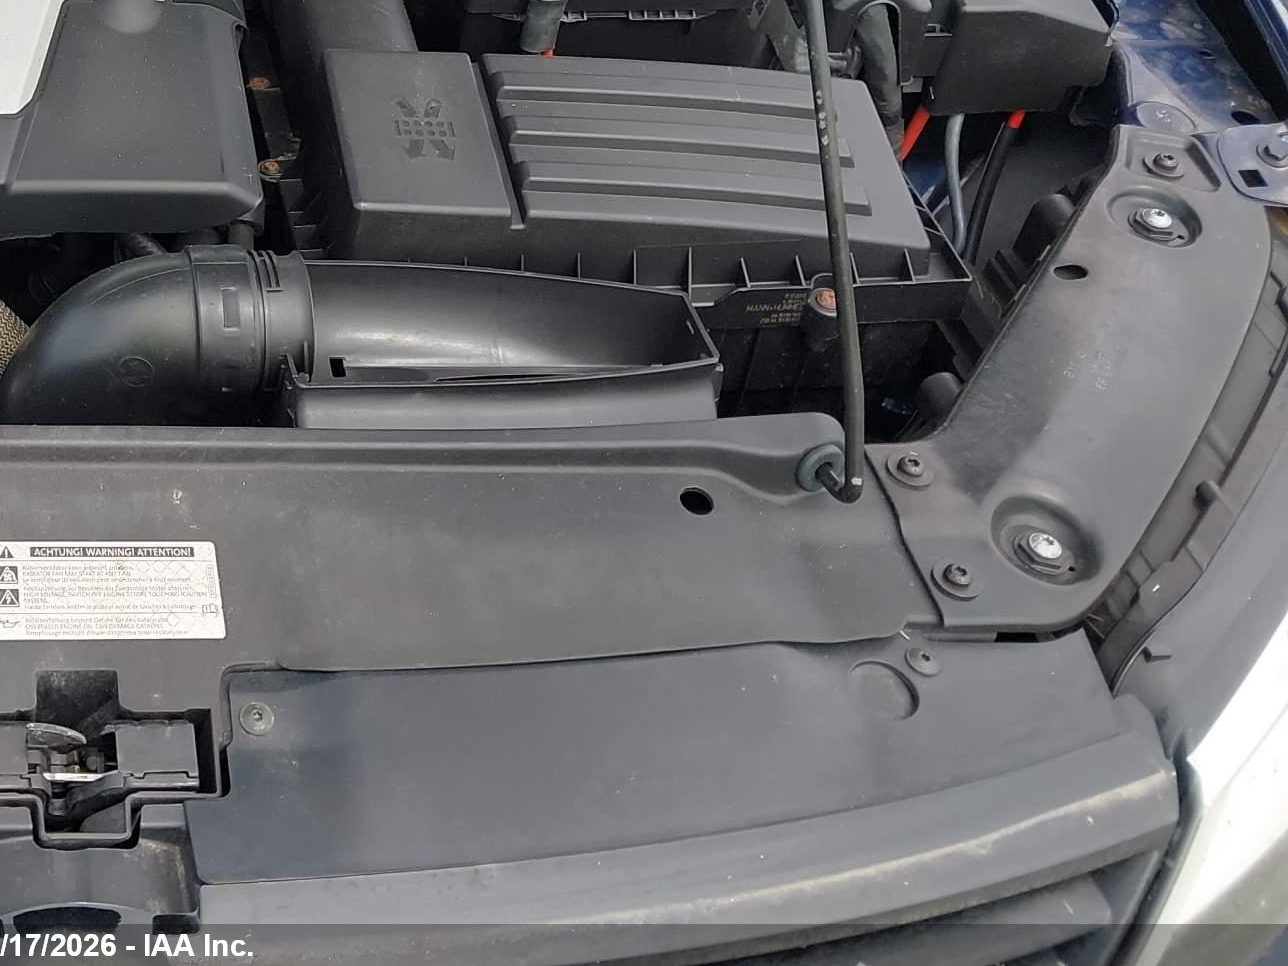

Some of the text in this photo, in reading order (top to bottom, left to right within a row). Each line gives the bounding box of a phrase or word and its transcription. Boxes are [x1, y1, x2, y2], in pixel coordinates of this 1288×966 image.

[34, 547, 191, 557] ACHTUNG! WARNING! ATTENTION!
